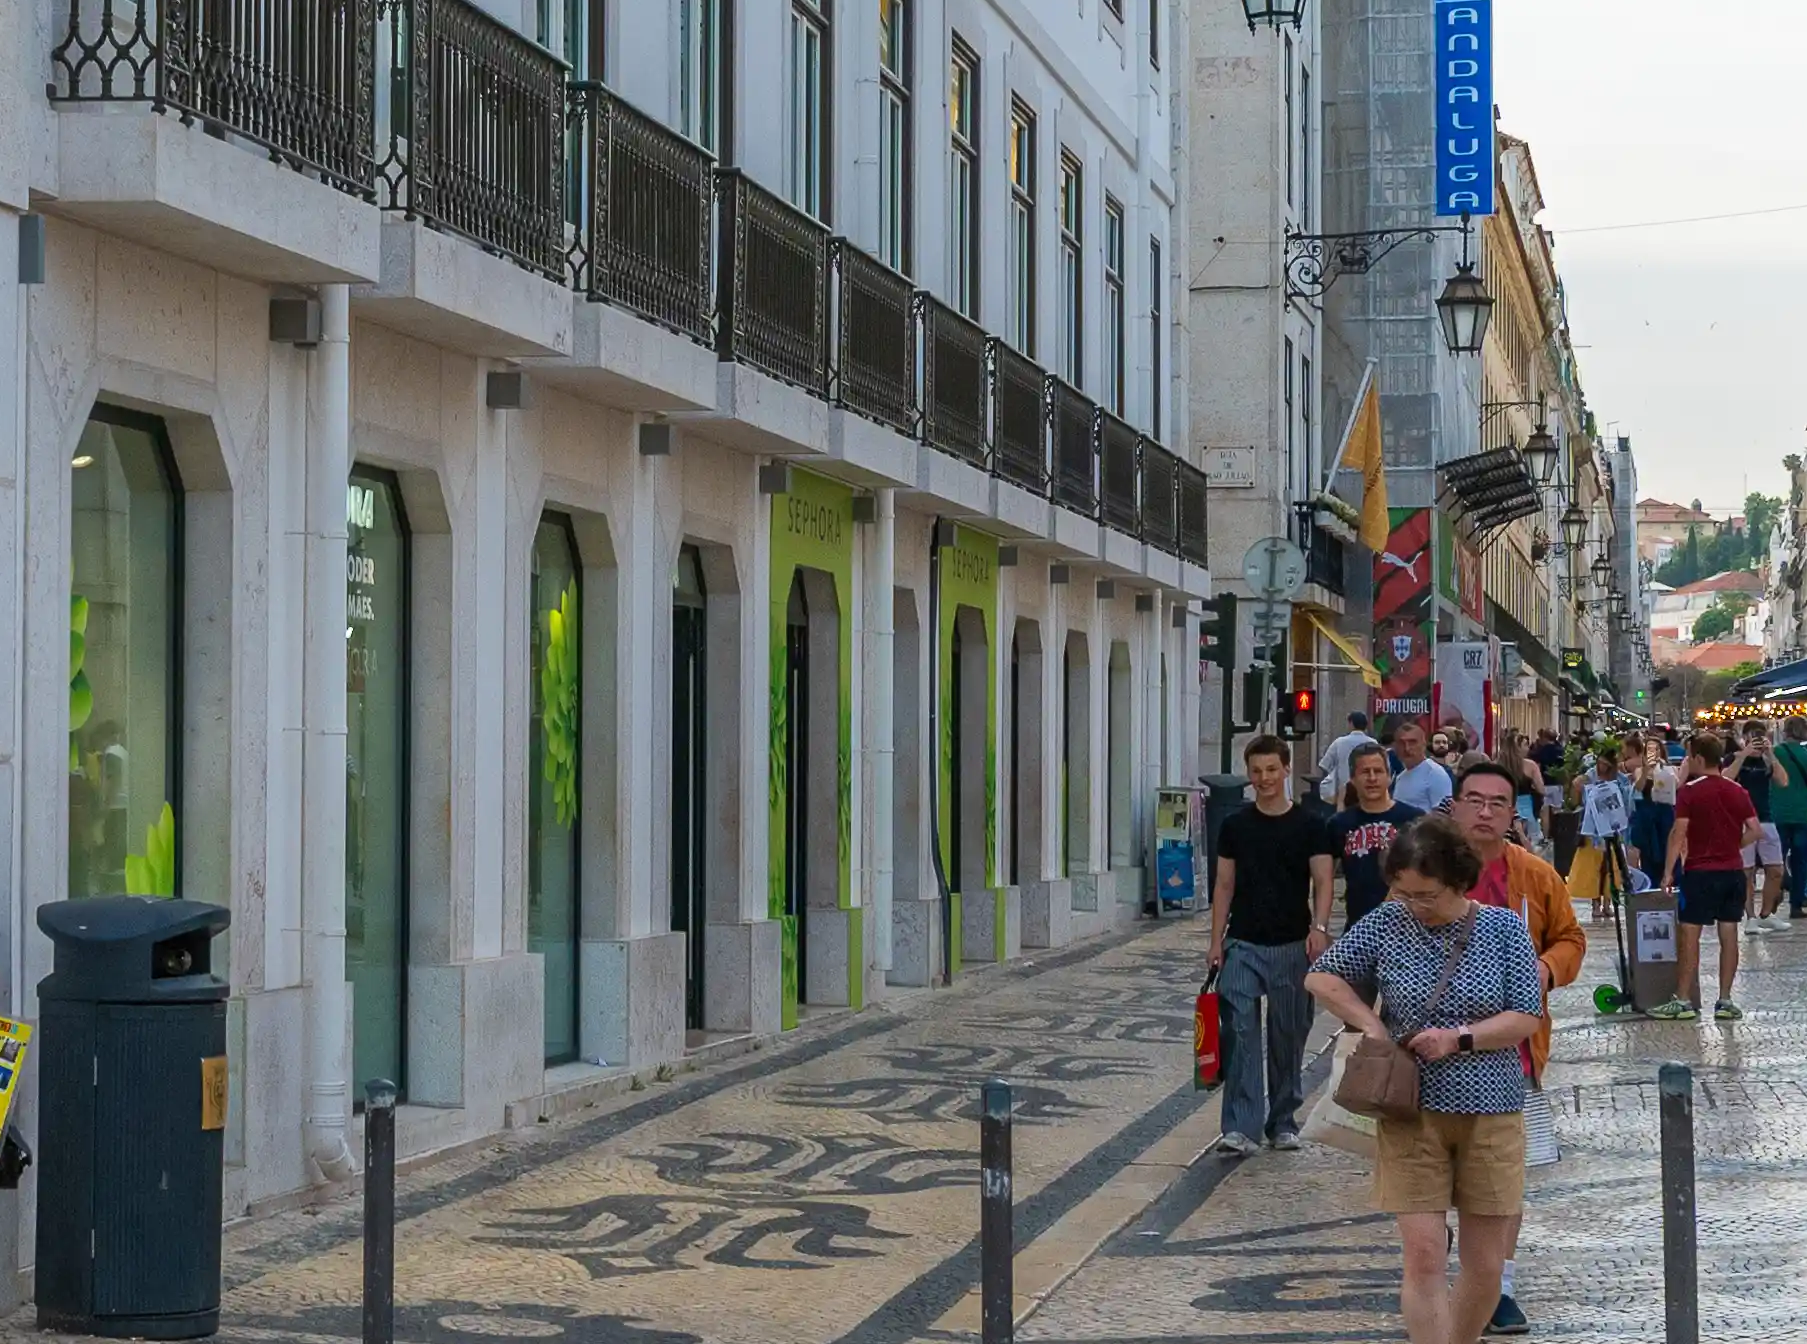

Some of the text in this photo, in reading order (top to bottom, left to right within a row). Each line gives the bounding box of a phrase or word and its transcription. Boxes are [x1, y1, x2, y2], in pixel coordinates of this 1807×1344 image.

[1447, 7, 1480, 209] ANDALUGA
[787, 497, 842, 546] SEPHORA
[347, 554, 375, 586] ODER
[952, 548, 990, 584] SEPHORA
[348, 589, 375, 621] MÃES.
[1463, 649, 1482, 666] CR7
[1375, 698, 1430, 714] PORTUGAL
